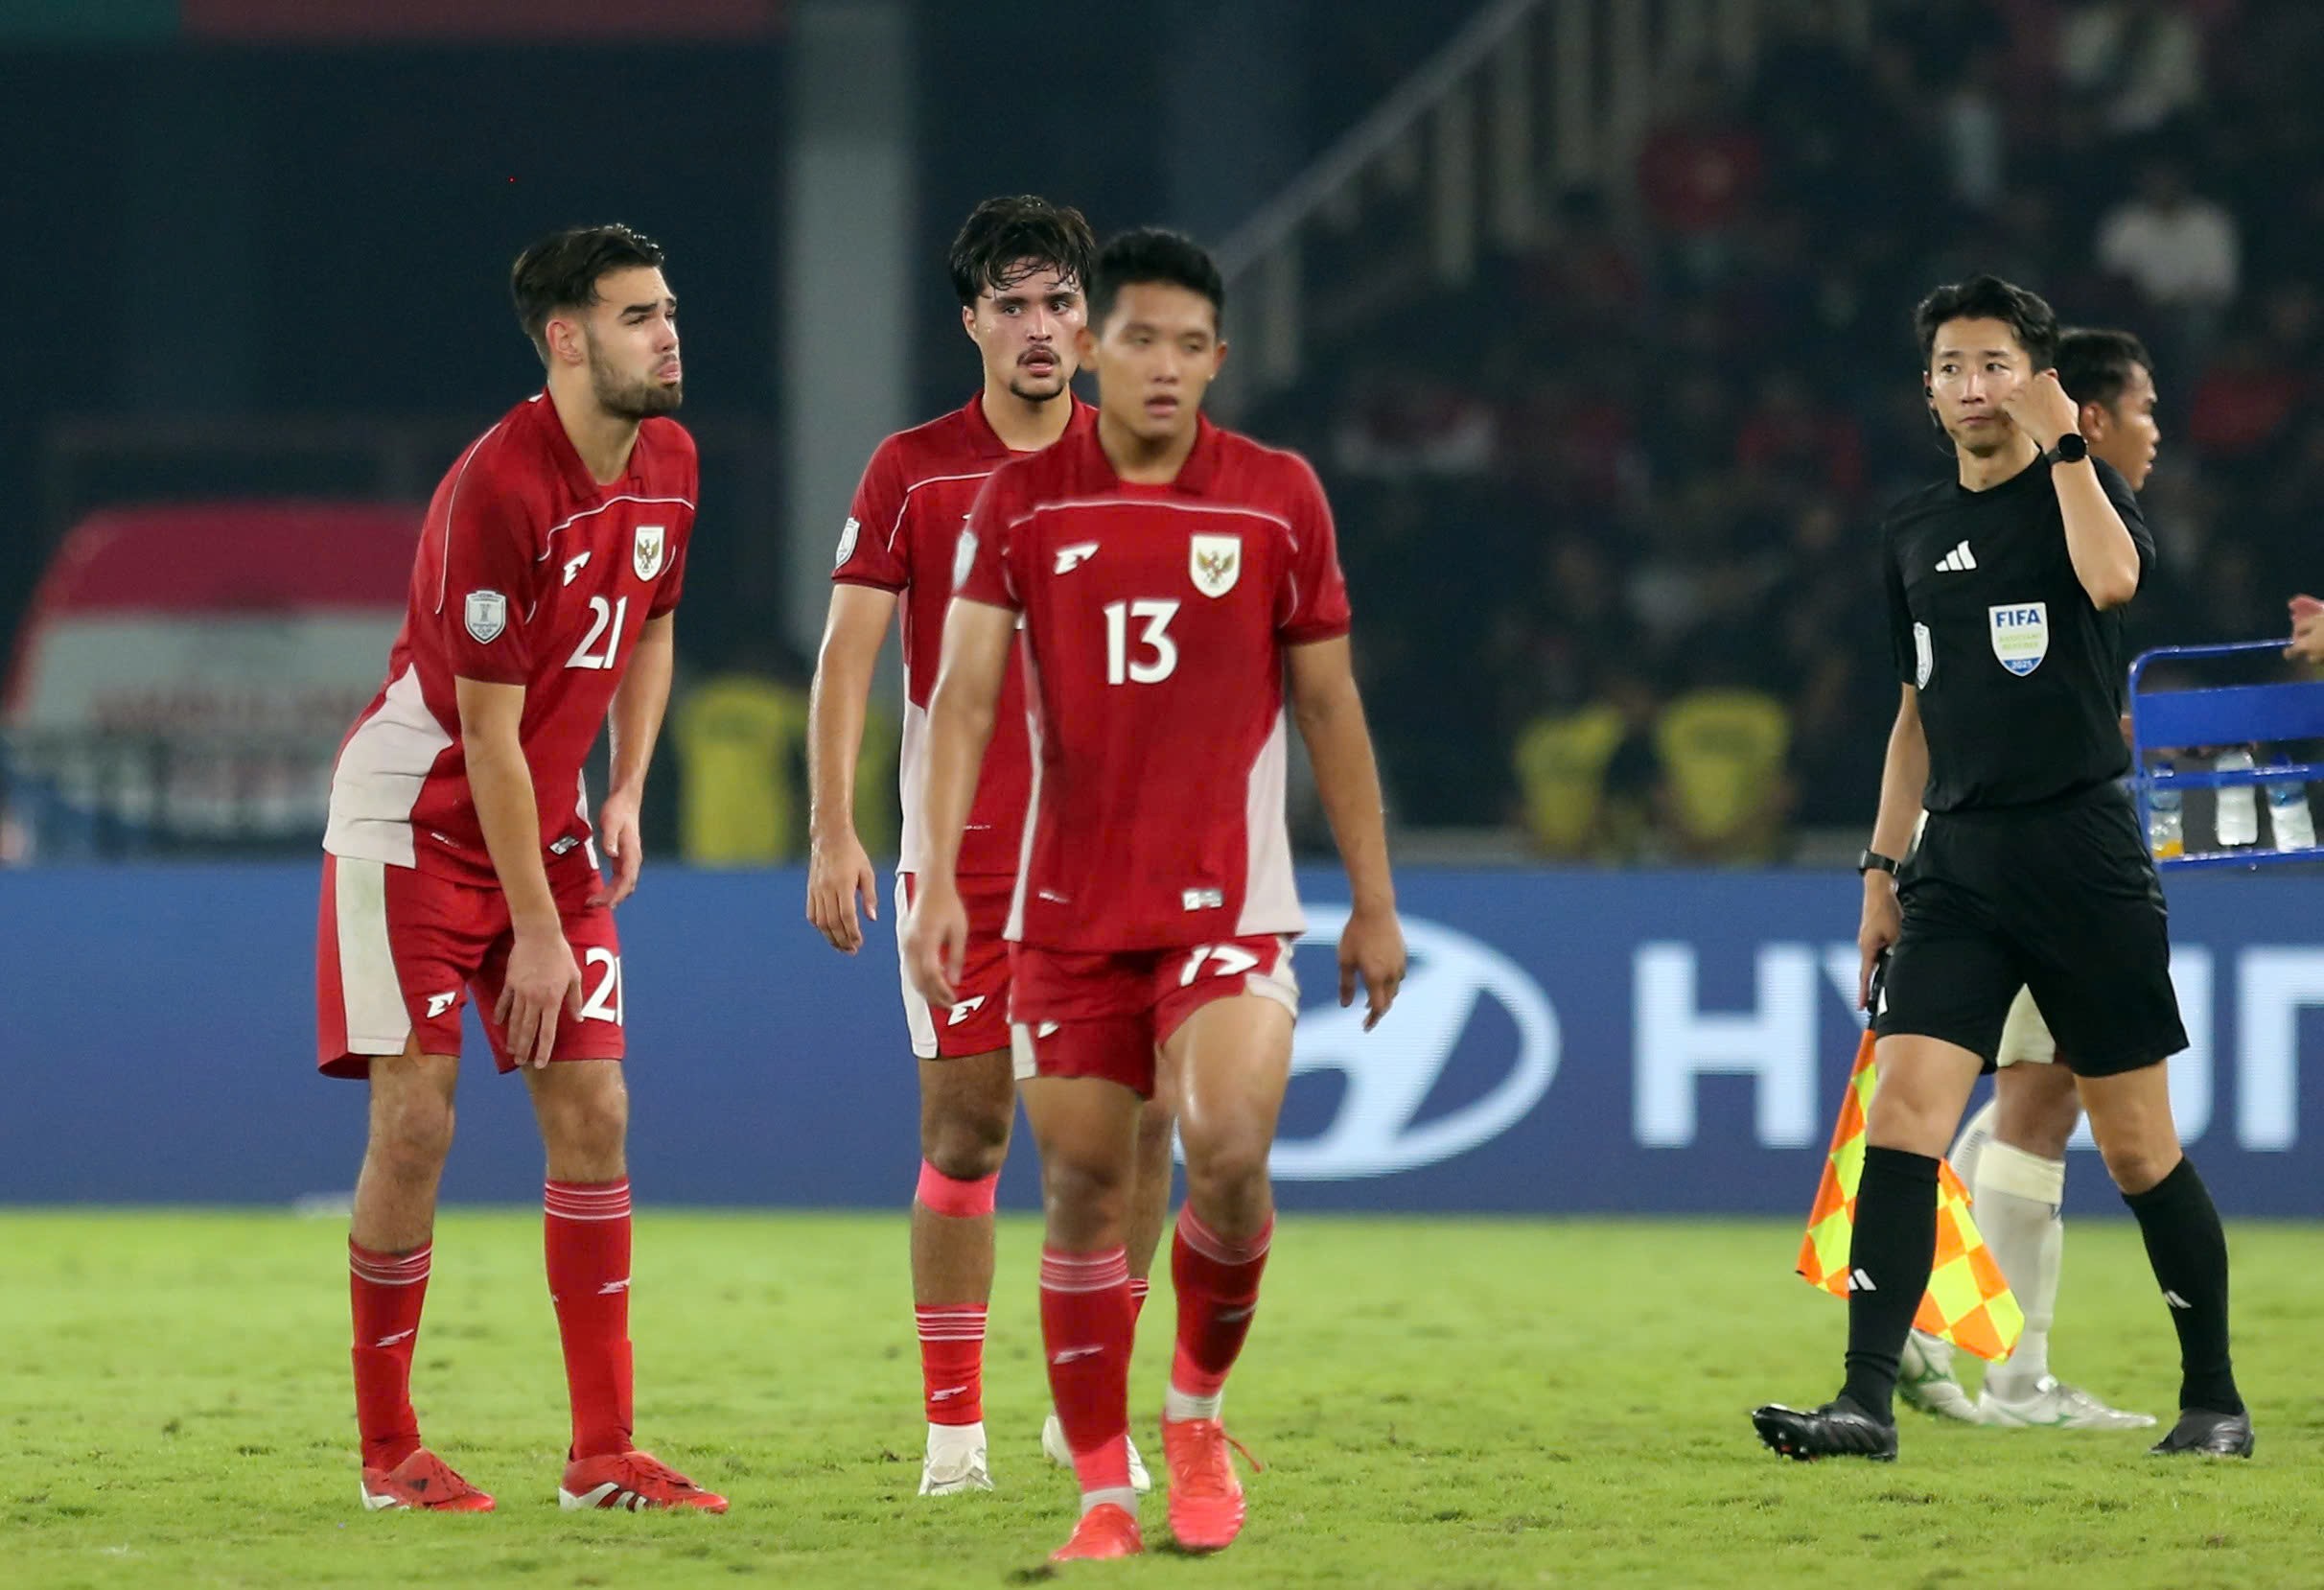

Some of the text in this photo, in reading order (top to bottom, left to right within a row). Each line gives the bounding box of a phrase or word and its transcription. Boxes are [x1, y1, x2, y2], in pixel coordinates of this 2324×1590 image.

[564, 596, 628, 669] 21
[1103, 600, 1181, 685] 13
[1995, 608, 2042, 628] FIFA
[581, 947, 623, 1027] 21
